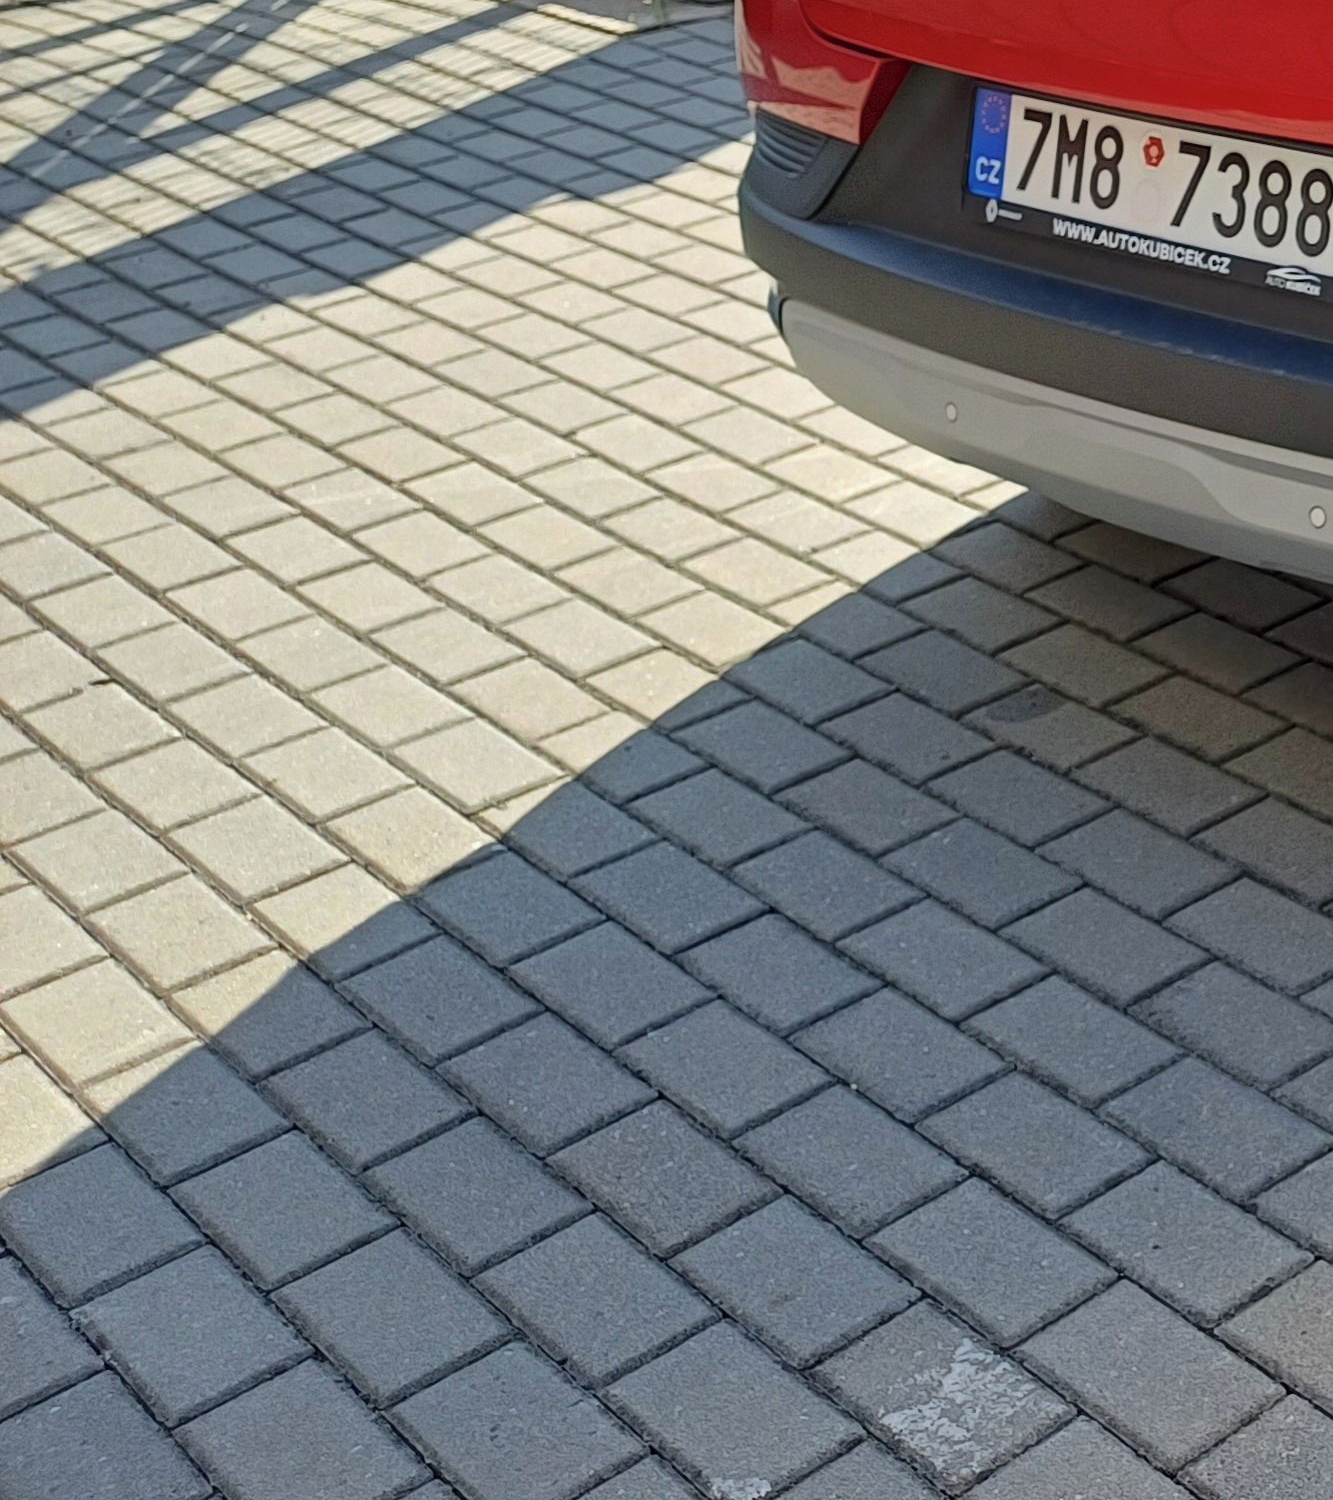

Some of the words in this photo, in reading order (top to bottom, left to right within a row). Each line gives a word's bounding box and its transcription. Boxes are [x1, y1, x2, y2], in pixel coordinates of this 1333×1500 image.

[975, 156, 1001, 185] CZ
[1016, 106, 1124, 210] 7M8
[1053, 217, 1231, 275] WWW.AUTOKUBICEK.CZ
